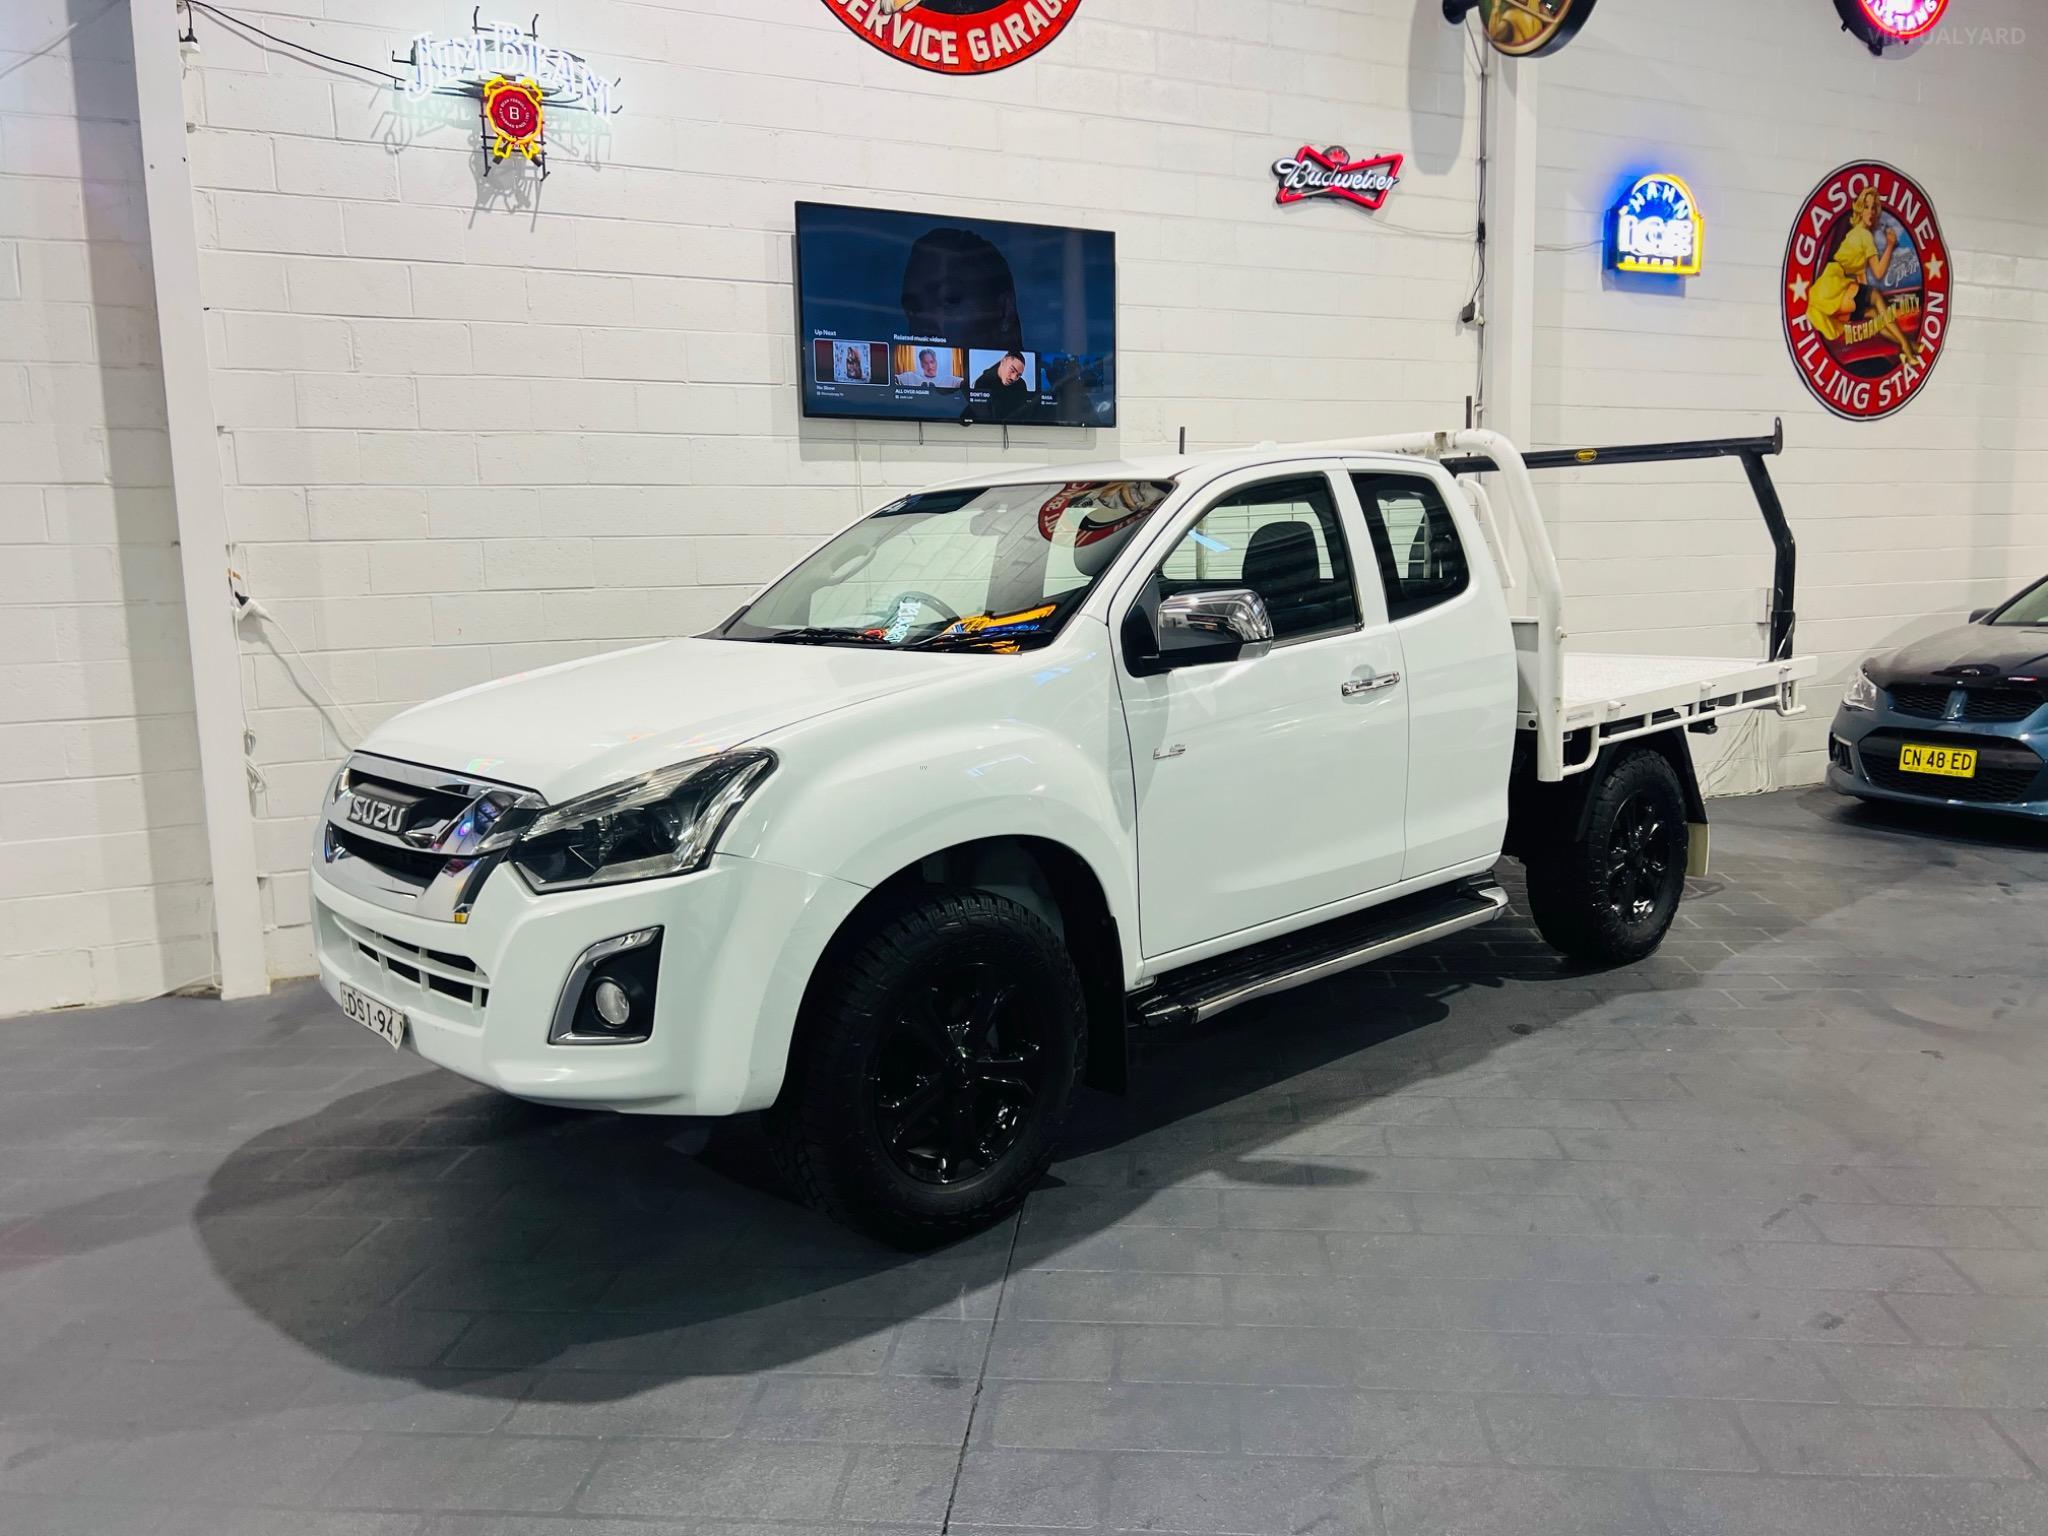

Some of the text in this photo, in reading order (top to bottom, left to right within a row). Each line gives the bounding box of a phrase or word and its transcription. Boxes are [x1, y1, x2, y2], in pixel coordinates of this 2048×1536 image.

[1867, 0, 1937, 31] USTANG
[967, 0, 1069, 63] GARAG
[509, 106, 520, 120] B
[1276, 158, 1399, 190] Budweiser
[1795, 173, 1935, 266] GASOLINE
[814, 329, 837, 337] Up Next
[893, 333, 914, 342] Related
[1792, 314, 1871, 410] FILLING
[1902, 748, 1921, 767] CN
[1926, 750, 1945, 769] 48
[1950, 751, 1972, 771] ED
[350, 795, 406, 832] SUZU
